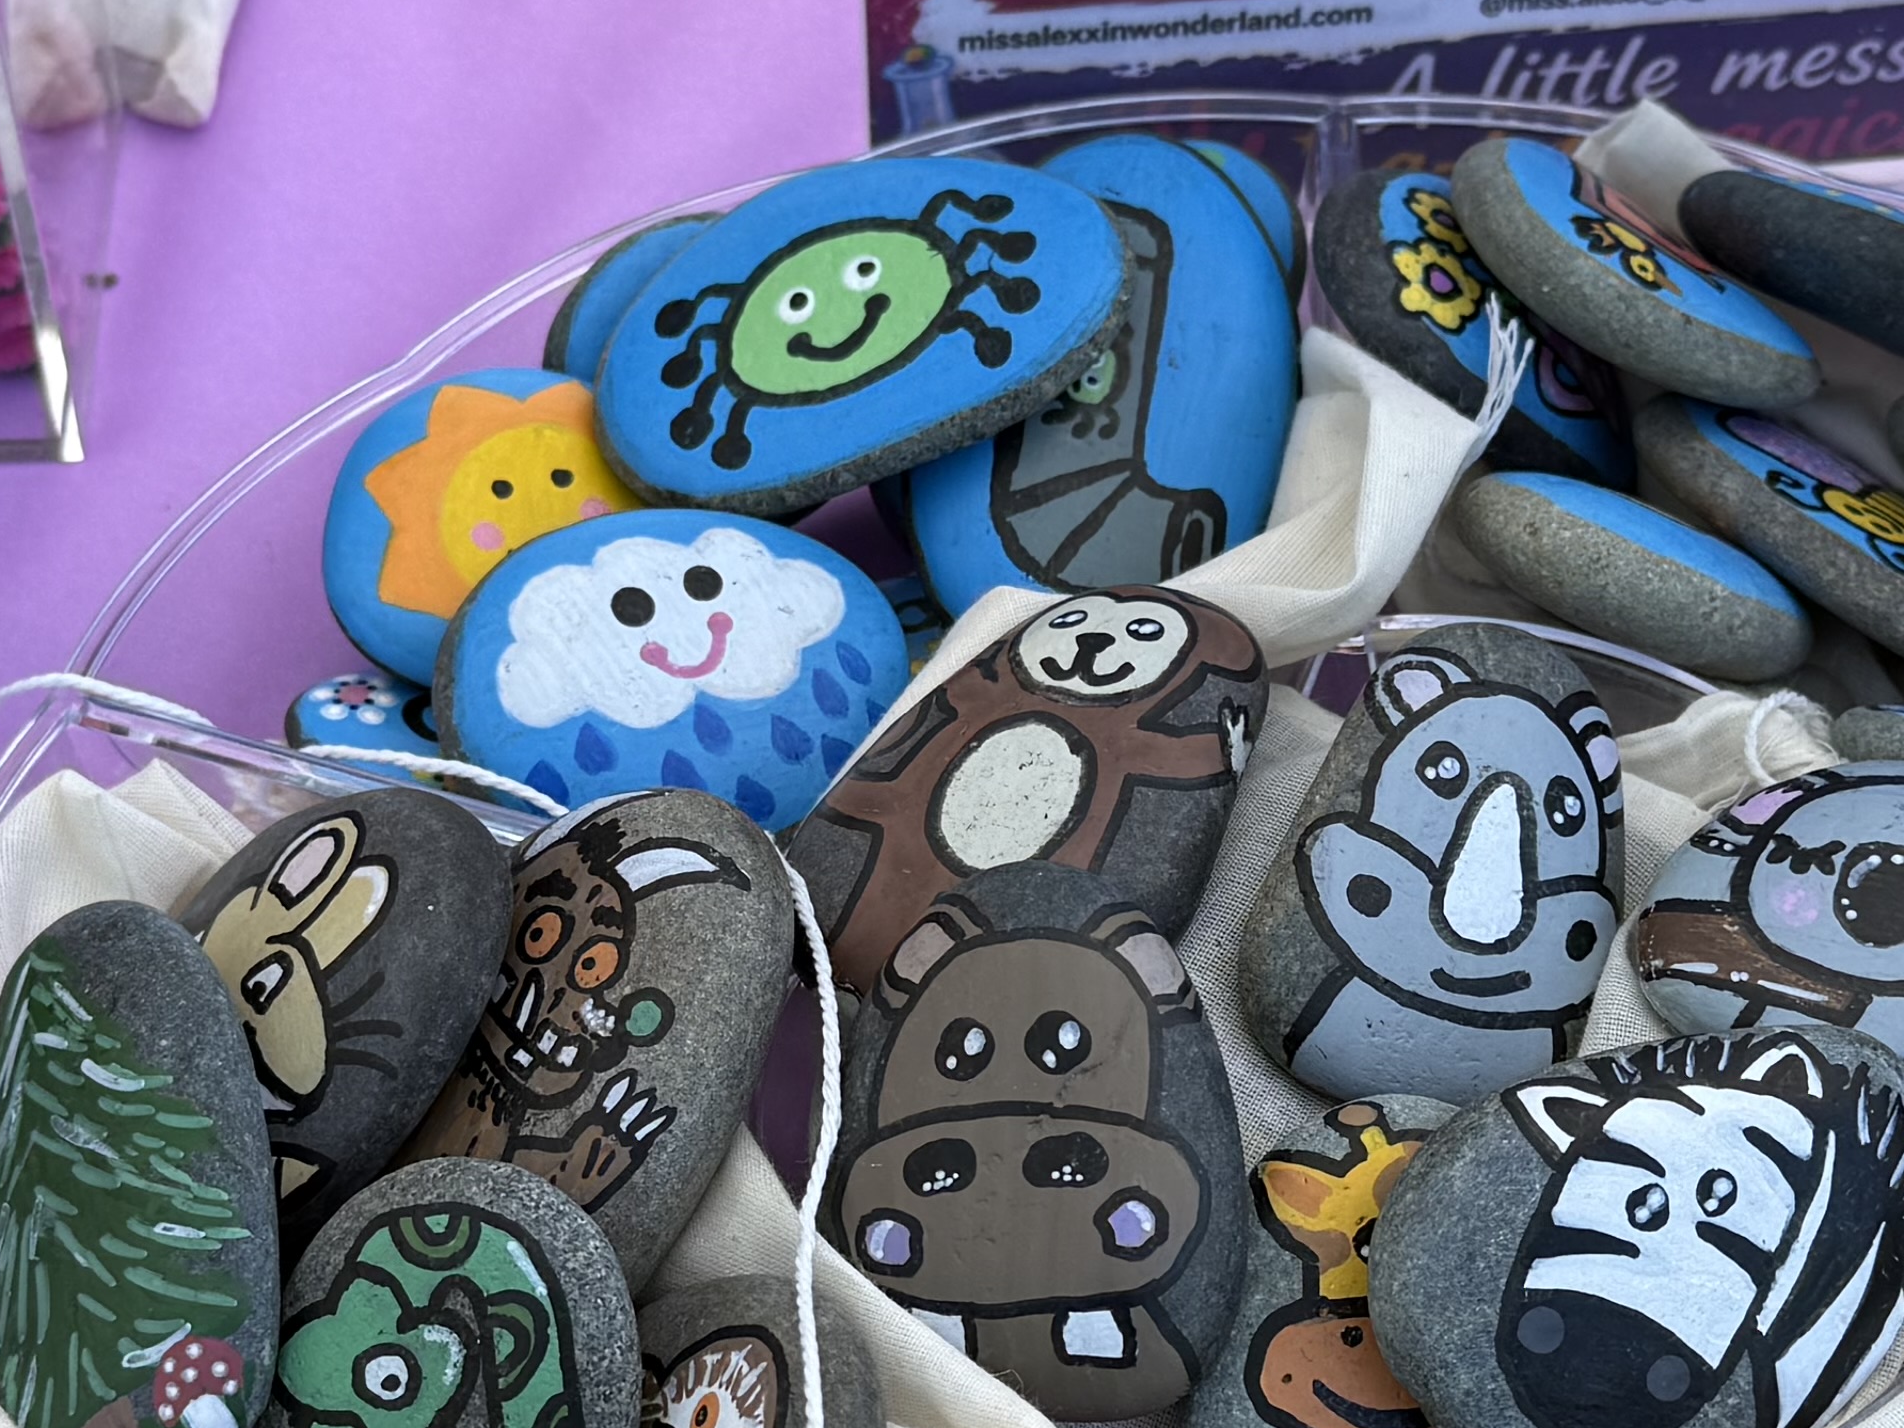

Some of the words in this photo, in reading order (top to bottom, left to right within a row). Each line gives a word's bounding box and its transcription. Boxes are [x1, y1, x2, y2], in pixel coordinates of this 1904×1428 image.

[958, 3, 1374, 53] missalexxinwonderland.com
[1363, 52, 1438, 134] A
[1480, 35, 1679, 132] little
